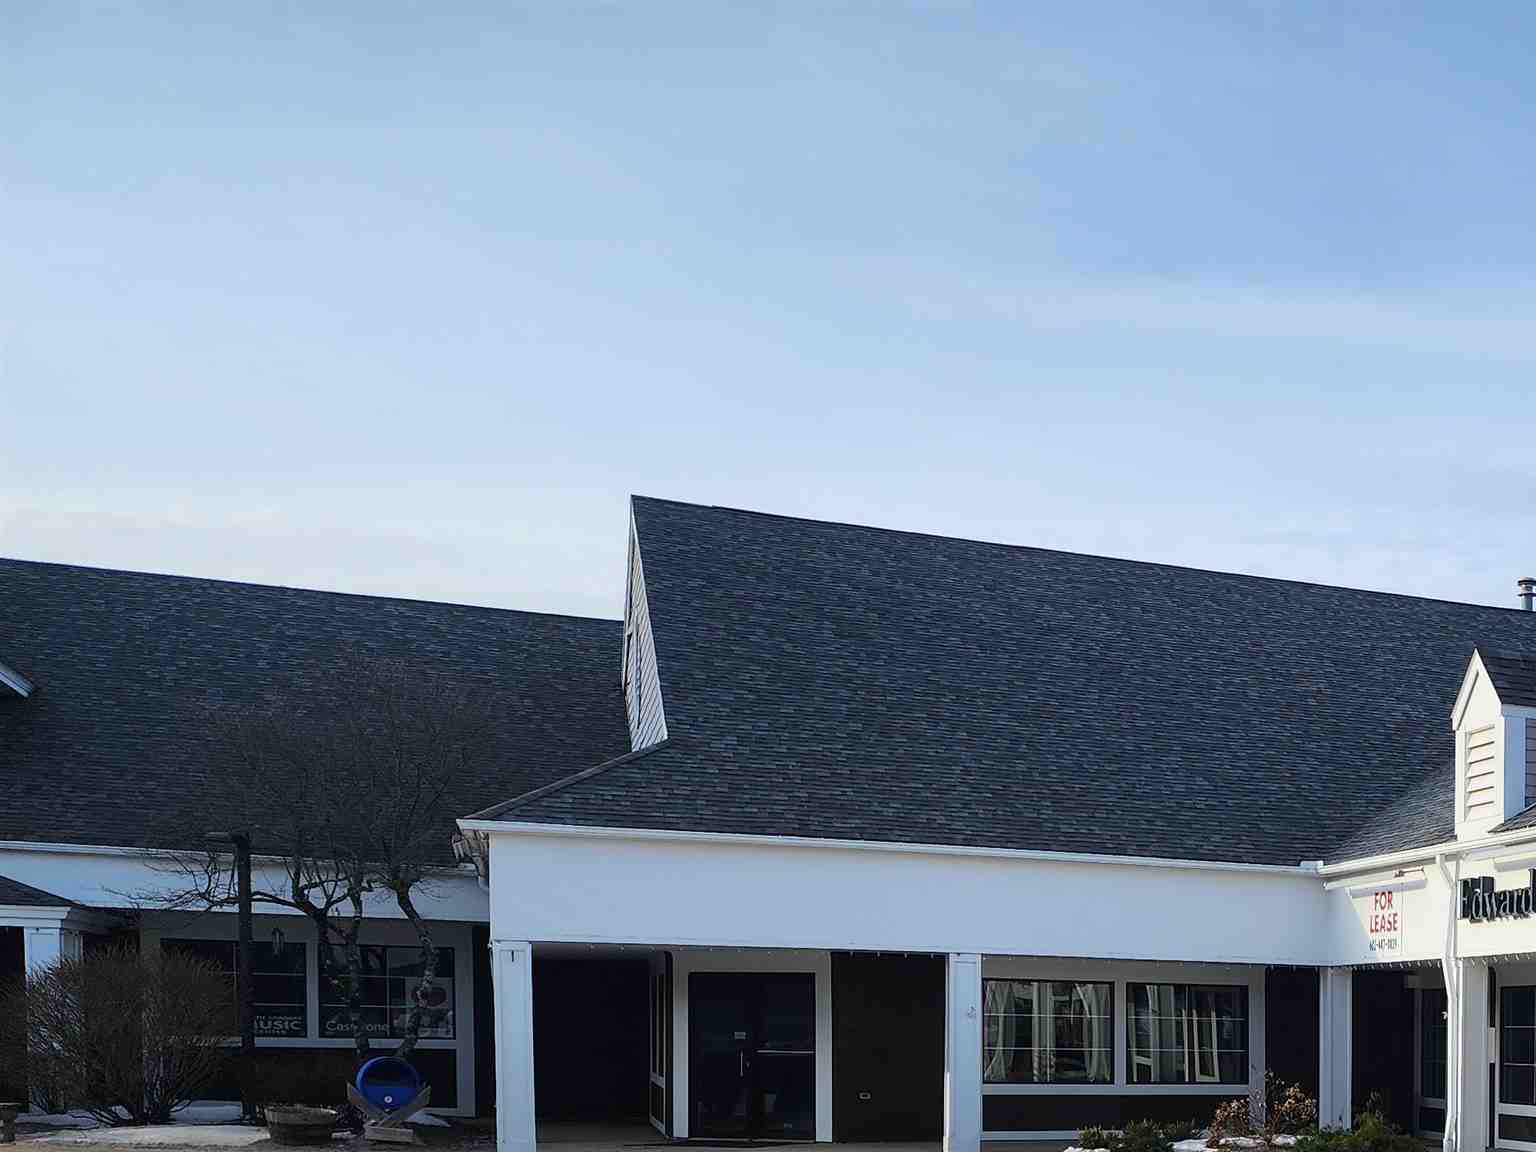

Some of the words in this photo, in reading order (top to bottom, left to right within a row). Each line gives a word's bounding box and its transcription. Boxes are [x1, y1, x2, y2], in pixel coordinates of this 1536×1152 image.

[1375, 891, 1393, 910] FOR
[1457, 870, 1534, 922] Edward
[1370, 912, 1398, 932] LEASE
